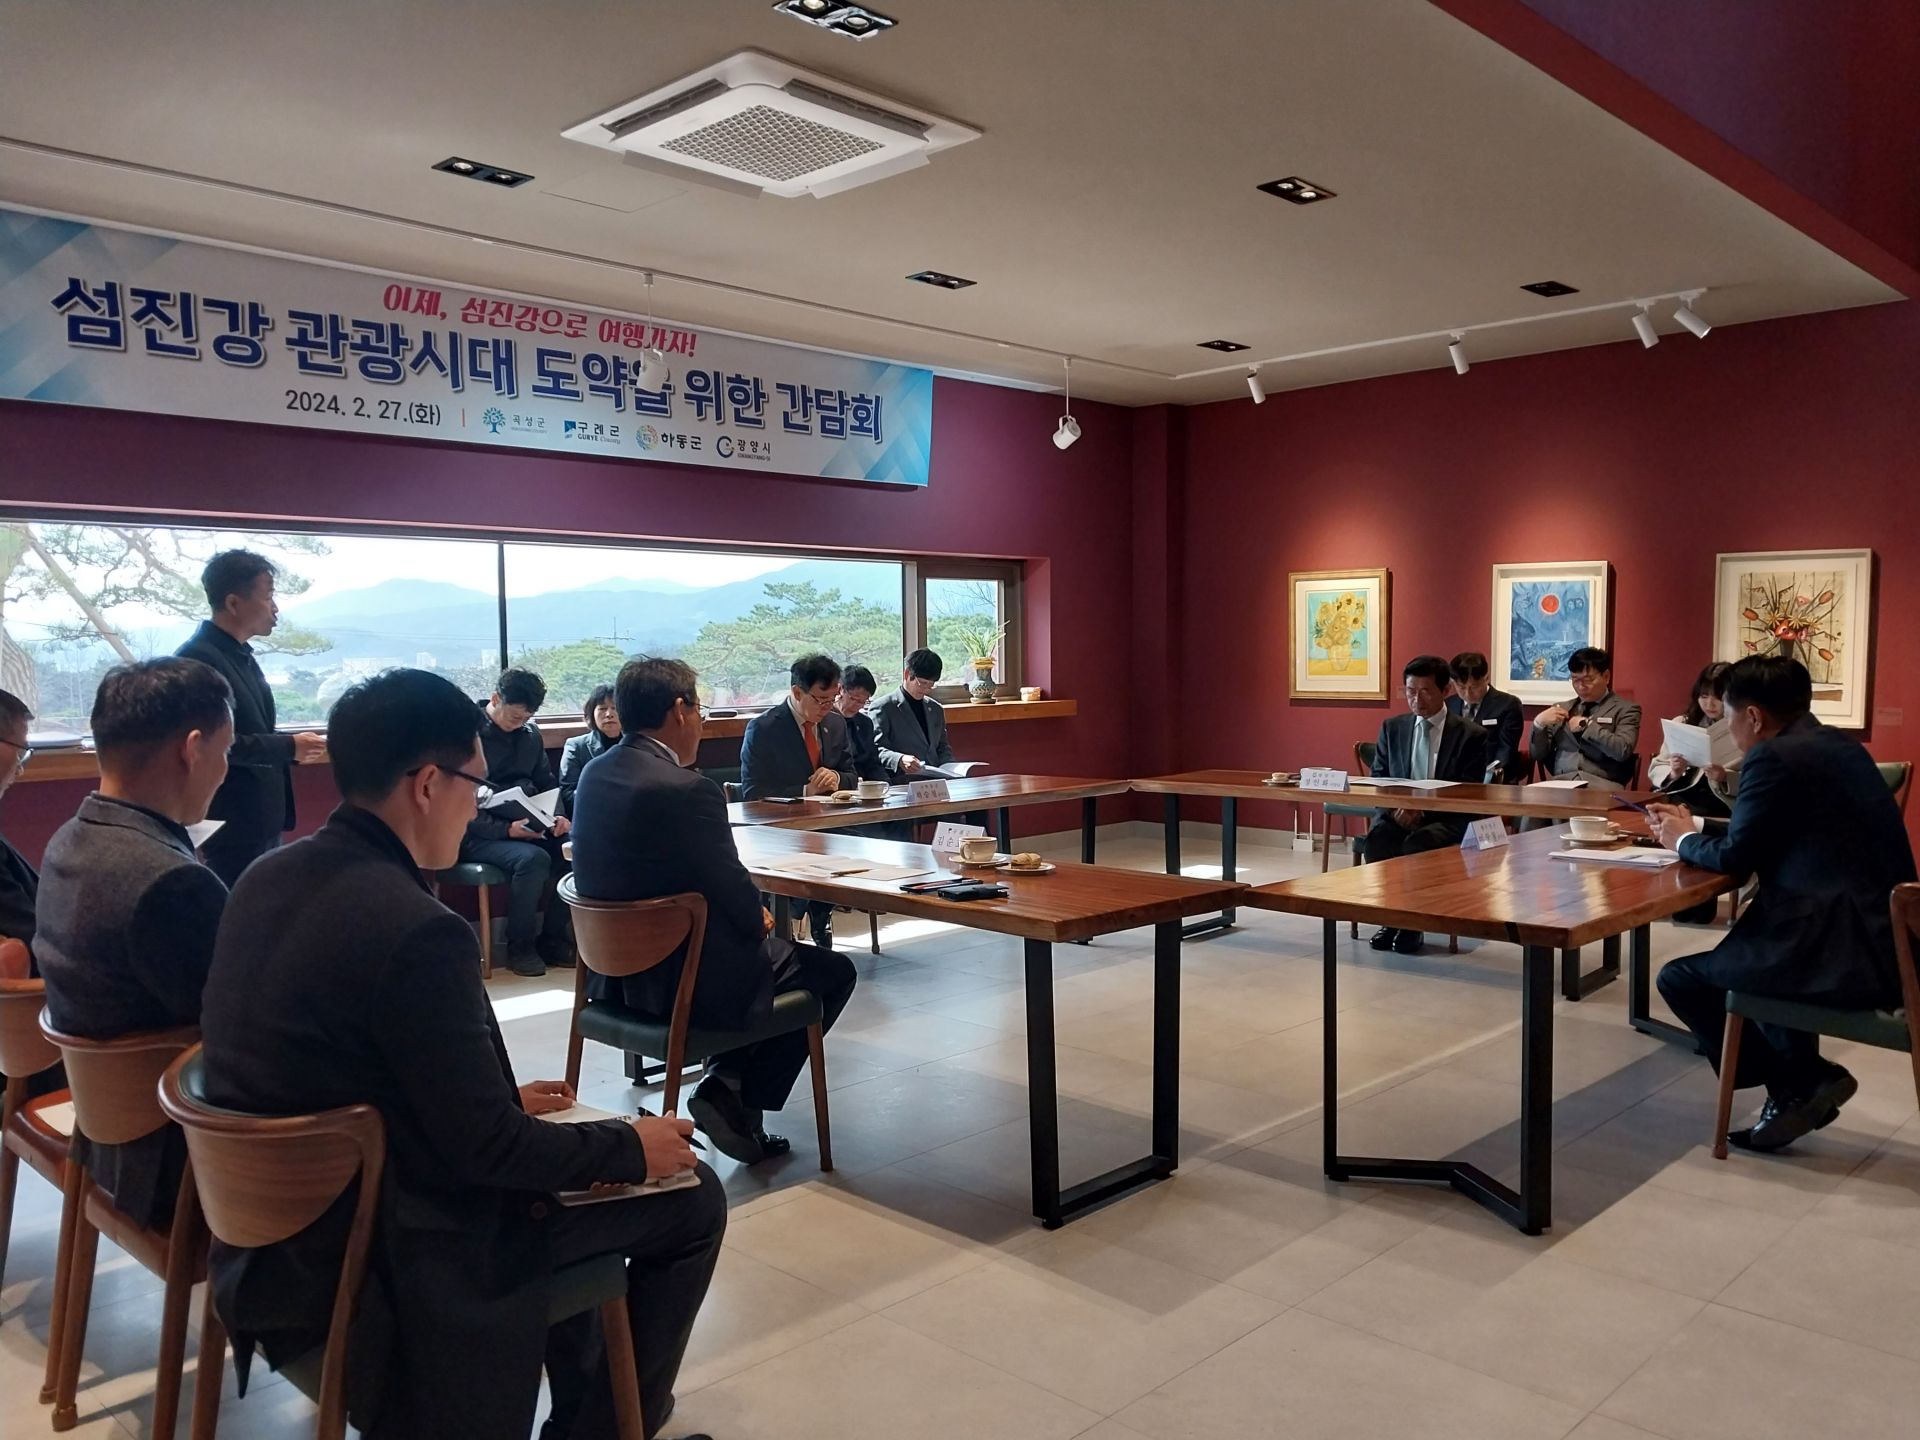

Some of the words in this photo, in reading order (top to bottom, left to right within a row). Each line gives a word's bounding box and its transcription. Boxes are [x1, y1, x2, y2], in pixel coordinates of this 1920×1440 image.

[383, 284, 447, 321] 이제,
[460, 297, 588, 339] 섬진강으로
[598, 318, 697, 358] 여행가자!
[50, 277, 273, 367] 섬진강
[285, 308, 518, 399] 관광시대
[683, 369, 766, 429] 위한
[775, 381, 883, 444] 간담회
[285, 389, 346, 417] 2024.
[353, 396, 371, 419] 2.
[378, 399, 441, 427] 27.(화)
[513, 414, 545, 429] 곡성군
[577, 433, 599, 442] GURYE
[660, 432, 702, 451] 하동군
[737, 439, 771, 455] 광양시
